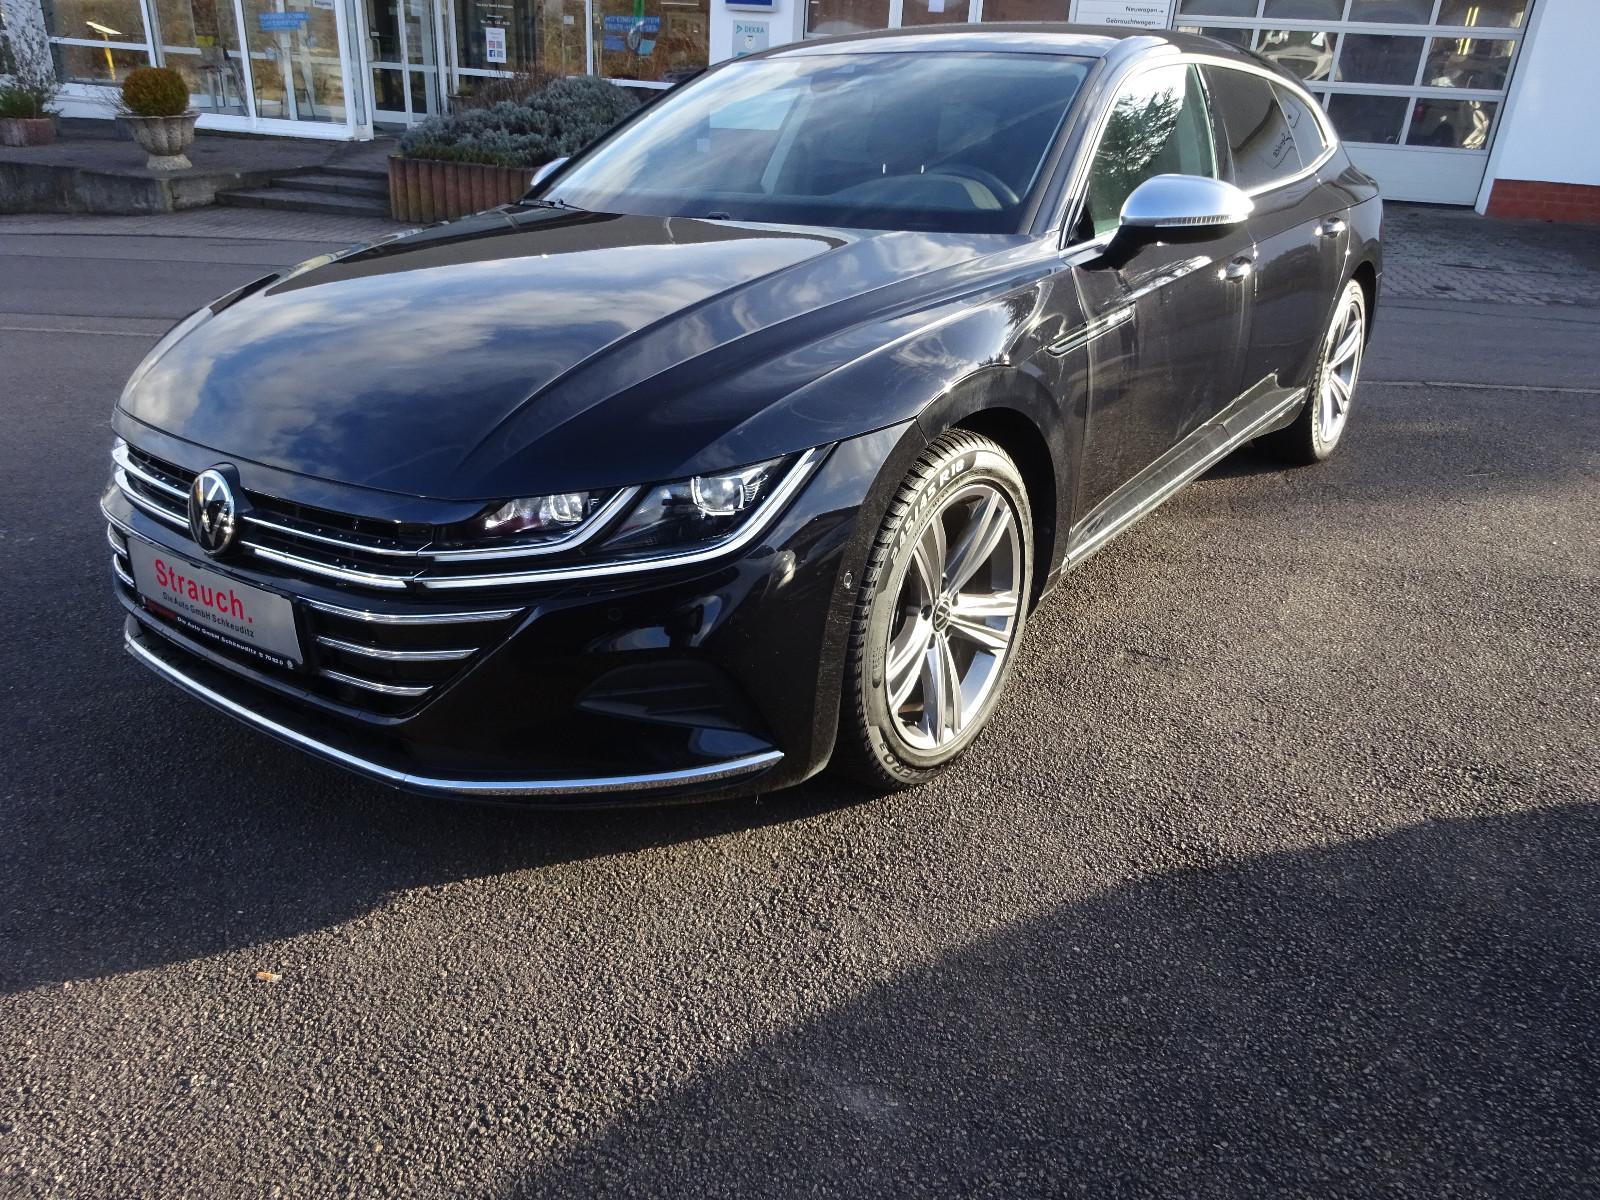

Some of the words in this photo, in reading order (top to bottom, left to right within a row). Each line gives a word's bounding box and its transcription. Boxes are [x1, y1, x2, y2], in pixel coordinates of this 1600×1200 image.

[1125, 6, 1158, 14] Neuwagen
[744, 25, 765, 33] DEKRA
[1105, 17, 1156, 27] Gebrauchtwagen
[155, 559, 253, 624] Strauch.
[189, 603, 212, 621] GmbH
[211, 614, 255, 639] Schkeuditz
[201, 629, 220, 641] GmbH
[221, 636, 258, 656] Schkeuditz
